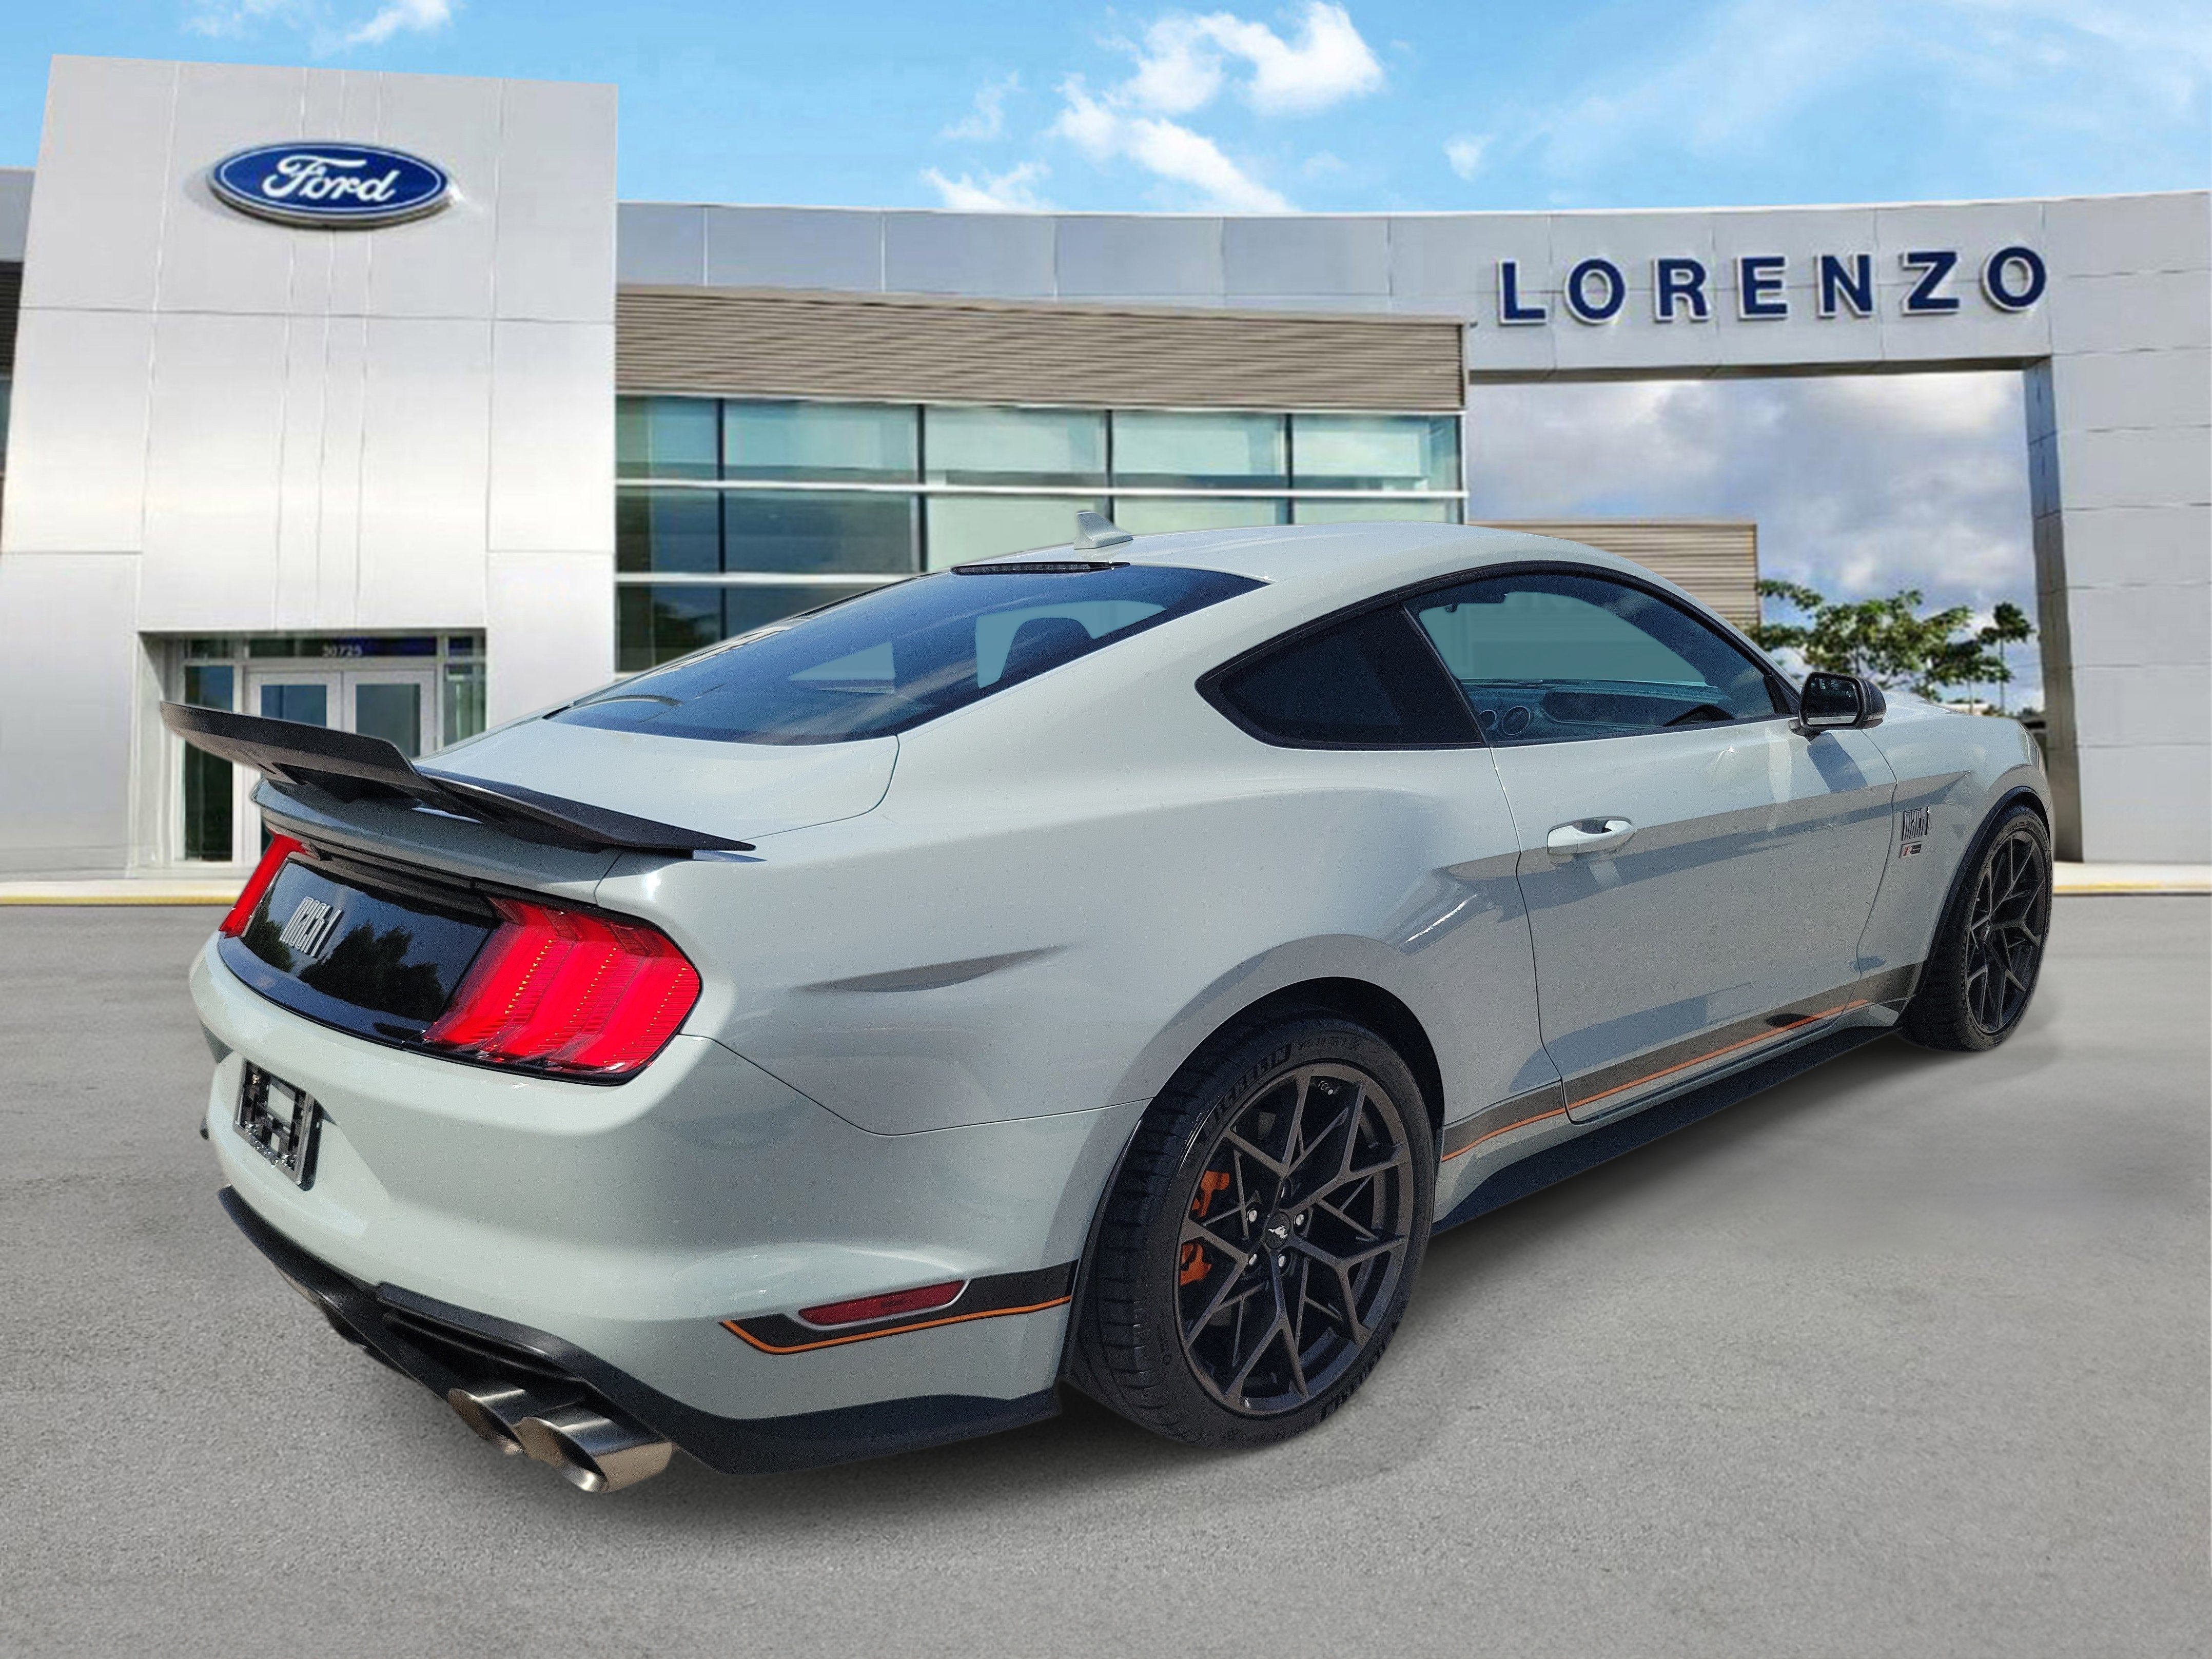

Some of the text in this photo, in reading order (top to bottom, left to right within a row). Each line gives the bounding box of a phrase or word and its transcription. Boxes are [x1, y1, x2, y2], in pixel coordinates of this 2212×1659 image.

[262, 154, 401, 202] Ford
[1498, 246, 2047, 326] LORENZO
[310, 908, 343, 957] 1
[1202, 1044, 1288, 1140] MICHELIN
